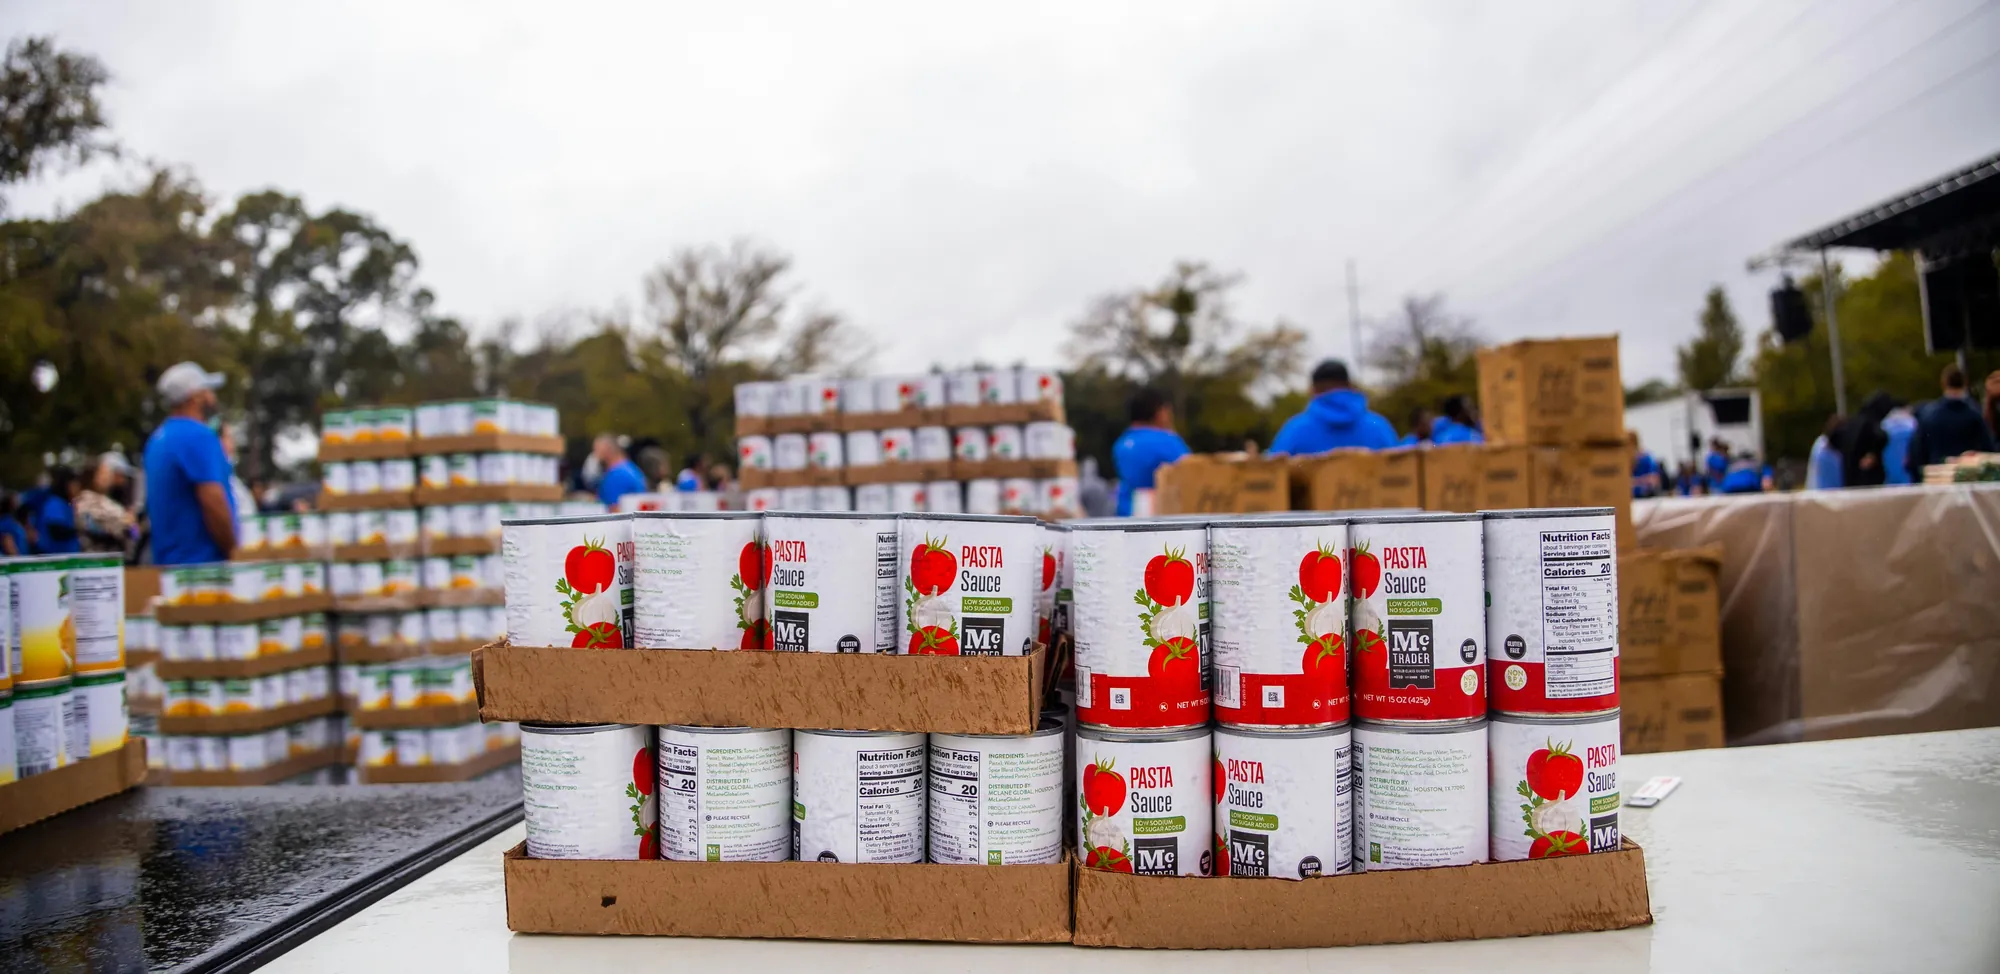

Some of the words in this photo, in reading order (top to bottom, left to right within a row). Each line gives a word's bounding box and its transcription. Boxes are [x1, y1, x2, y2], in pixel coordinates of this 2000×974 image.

[1543, 533, 1588, 542] Nutrition
[1591, 532, 1610, 541] Facts
[774, 540, 807, 562] PASTA
[961, 545, 1003, 568] PASTA
[1383, 547, 1427, 569] PASTA
[1544, 568, 1586, 576] Calories
[1600, 563, 1611, 574] 20
[774, 564, 805, 587] Sauce
[961, 570, 1001, 593] Sauce
[1384, 572, 1426, 593] Sauce
[1392, 653, 1430, 664] TRADER
[1507, 669, 1523, 677] NON
[1191, 700, 1199, 708] WT
[1408, 696, 1431, 705] (425g)
[674, 746, 697, 757] Facts
[859, 752, 904, 761] Nutrition
[905, 748, 923, 758] Facts
[952, 752, 979, 762] Facts
[1587, 743, 1616, 769] PASTA
[1130, 766, 1173, 789] PASTA
[1228, 758, 1264, 784] PASTA
[681, 779, 696, 790] 20
[1587, 771, 1616, 793] Sauce
[859, 786, 900, 795] Calories
[961, 784, 978, 796] 20
[1228, 783, 1263, 808] Sauce
[1131, 791, 1172, 813] Sauce
[1241, 813, 1265, 821] SODIUM
[1233, 863, 1265, 876] TRADER
